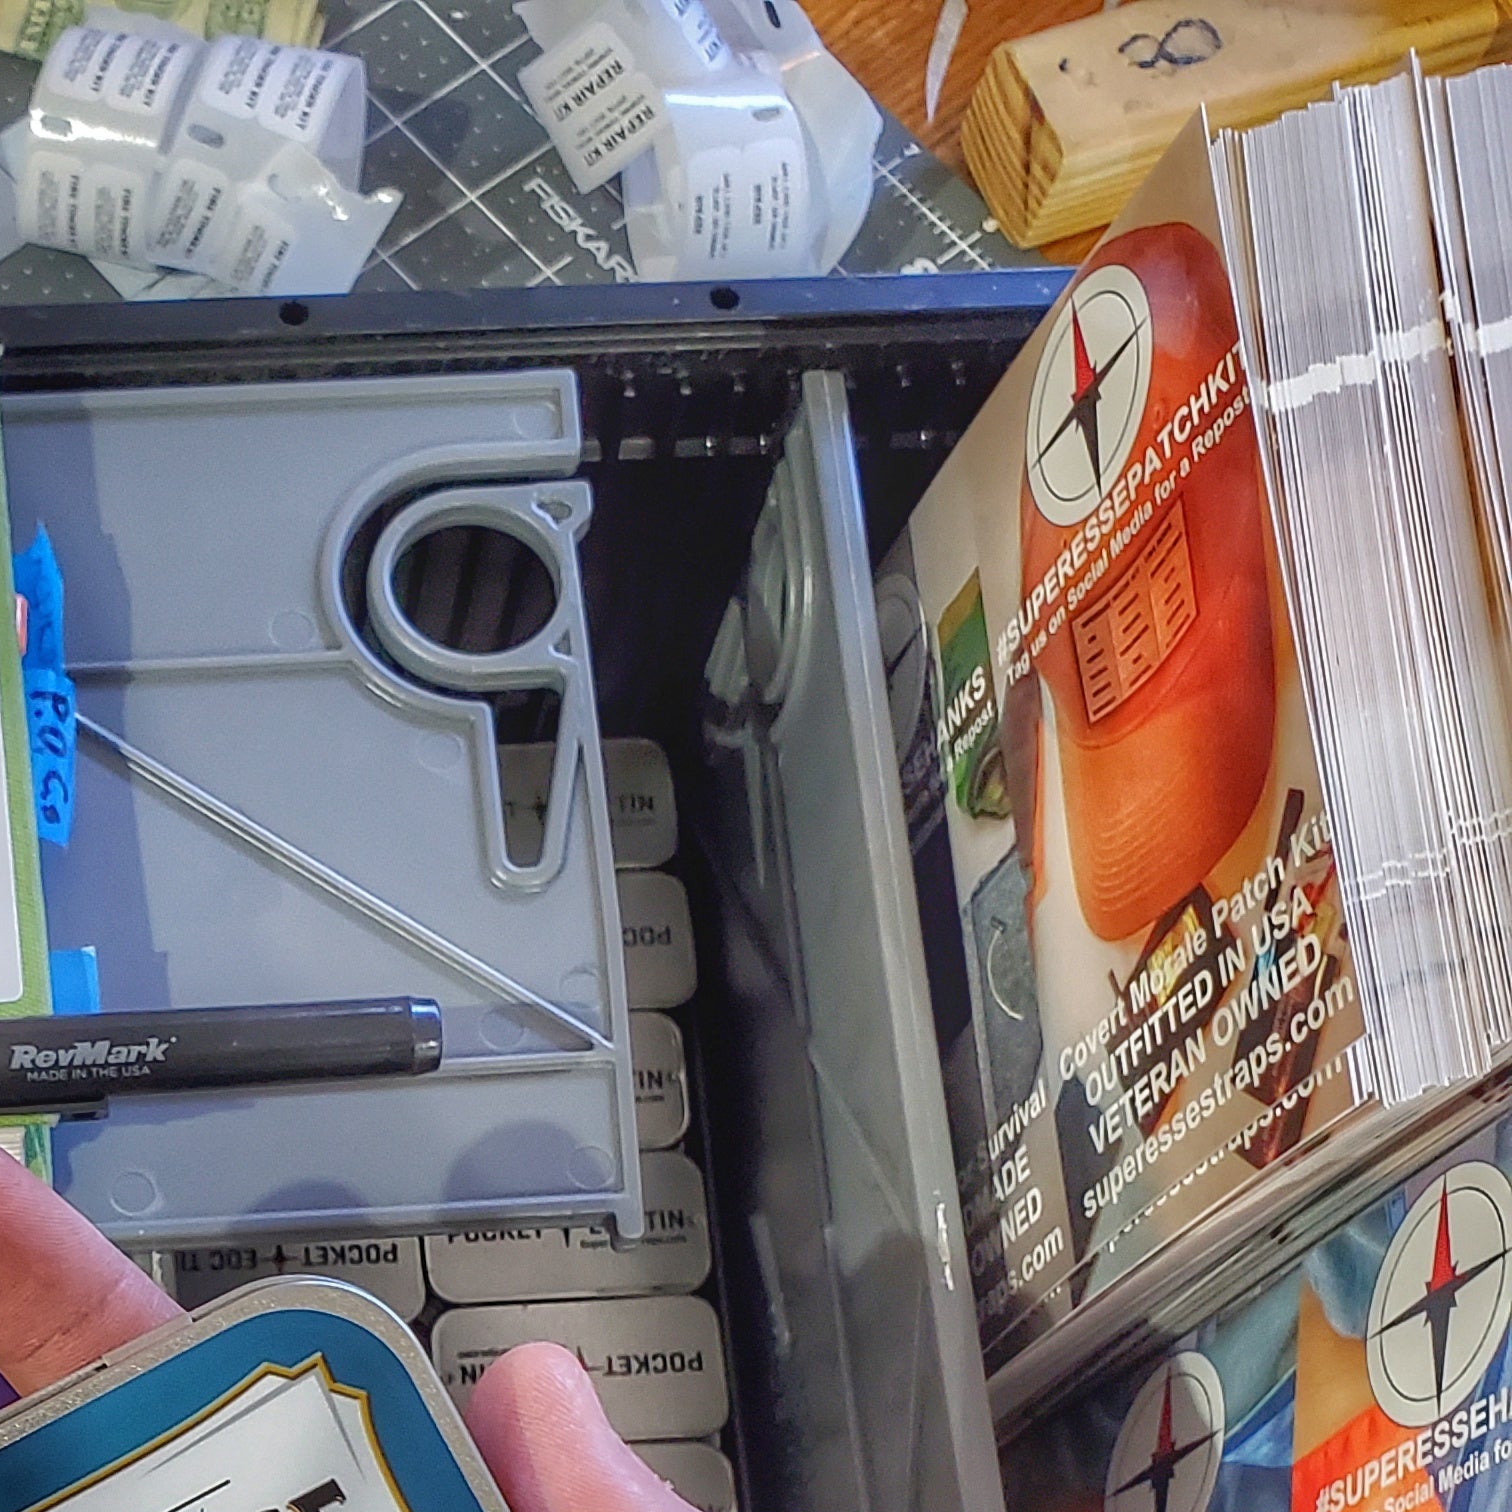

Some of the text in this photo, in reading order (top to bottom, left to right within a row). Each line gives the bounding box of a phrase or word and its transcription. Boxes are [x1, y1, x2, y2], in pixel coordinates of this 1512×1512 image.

[571, 59, 625, 106] REPAIR
[554, 102, 572, 122] KIT
[603, 105, 655, 152] REPAIR
[584, 147, 602, 167] KIT
[996, 339, 1246, 667] #SUPERESSEPATCHKIT
[1006, 385, 1249, 686] Tag us on Social Media for a Repost
[1061, 808, 1333, 1082] Covert Morale Patch Kit
[1085, 887, 1315, 1105] OUTFITTED IN USA
[9, 1037, 169, 1070] RevMark
[1088, 1026, 1208, 1156] VETERAN
[1211, 932, 1323, 1048] OWNED
[27, 1065, 151, 1082] MADE IN THE USA
[1082, 974, 1355, 1219] superessestraps.com
[986, 1078, 1047, 1161] urvival
[645, 1210, 685, 1231] TIN
[303, 1243, 398, 1267] POCKET
[603, 1352, 704, 1376] POCKET
[1438, 1451, 1490, 1493] Media
